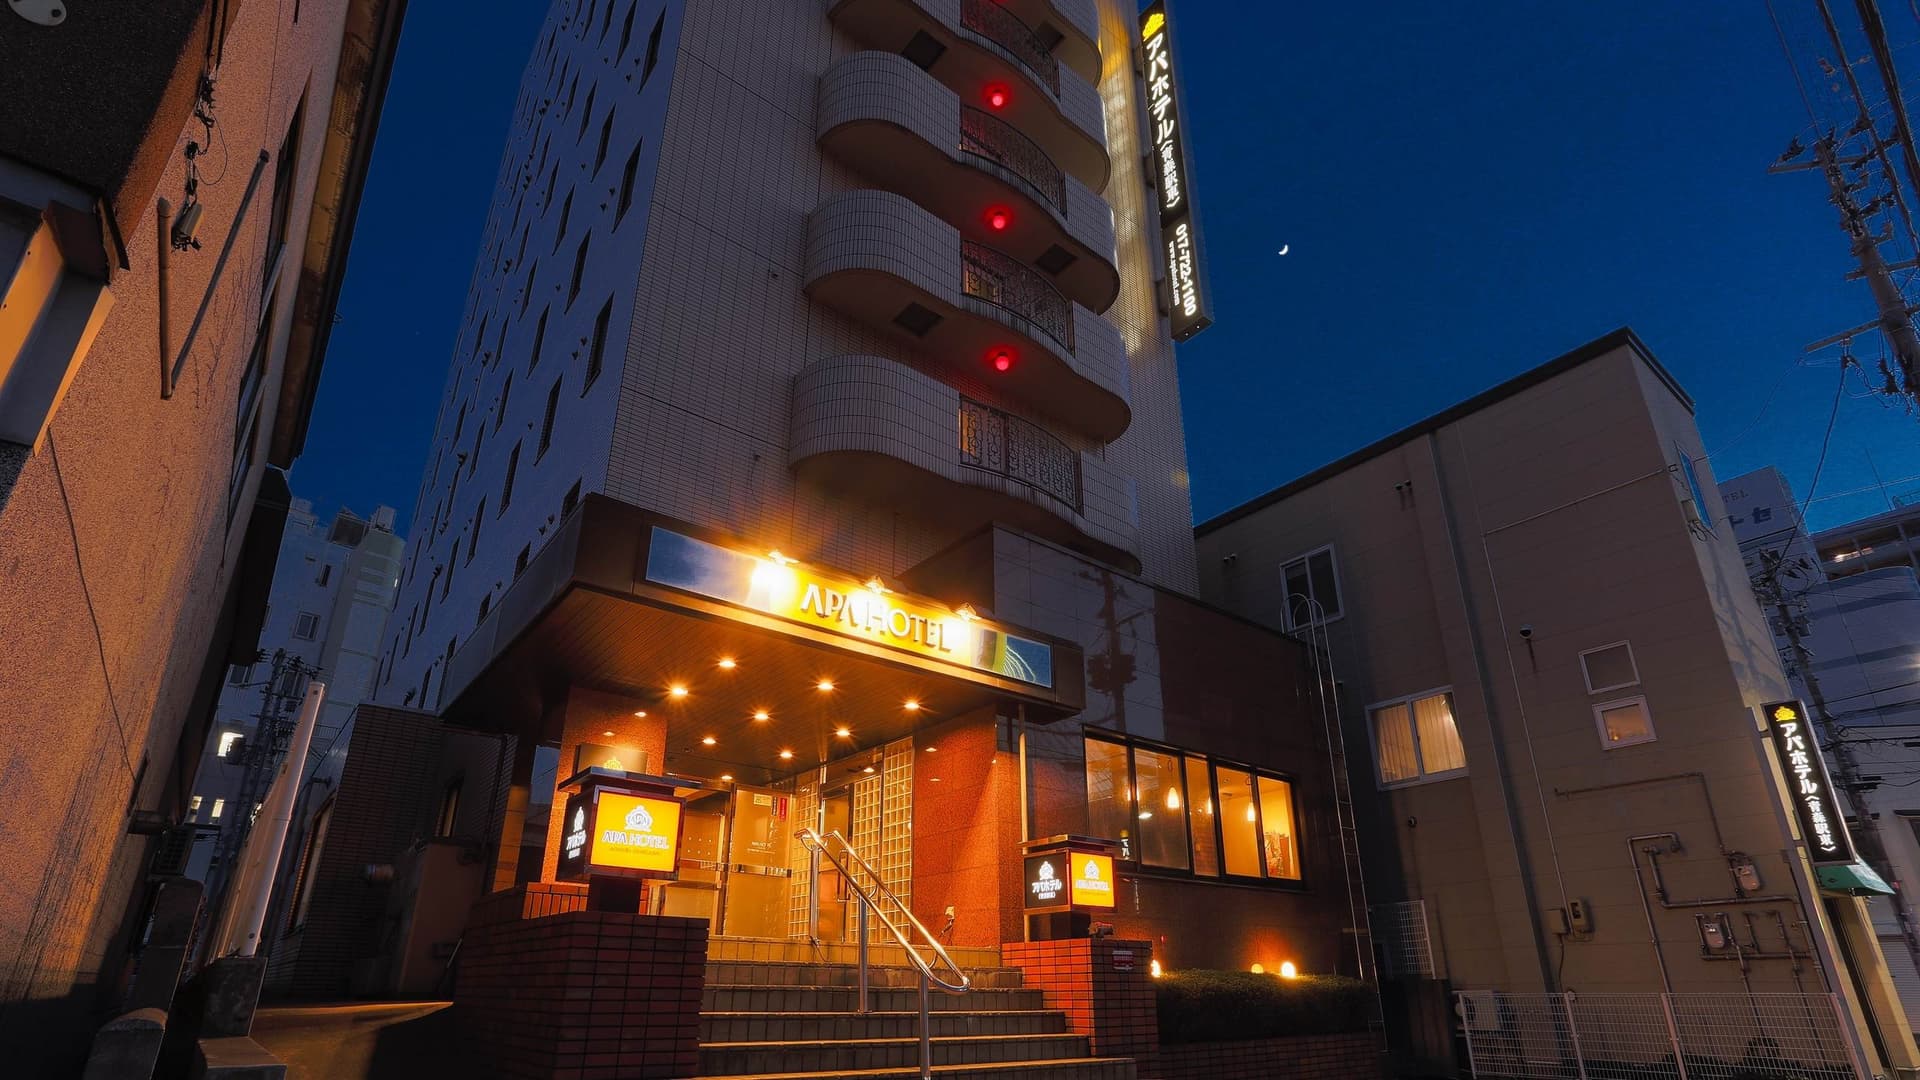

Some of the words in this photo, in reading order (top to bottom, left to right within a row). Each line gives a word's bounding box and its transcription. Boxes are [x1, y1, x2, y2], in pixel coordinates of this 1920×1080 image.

[1175, 223, 1197, 317] 017-722-1100
[801, 583, 858, 627] APA
[863, 597, 952, 652] HOTEL
[601, 831, 628, 846] APA
[628, 834, 670, 850] HOTEL
